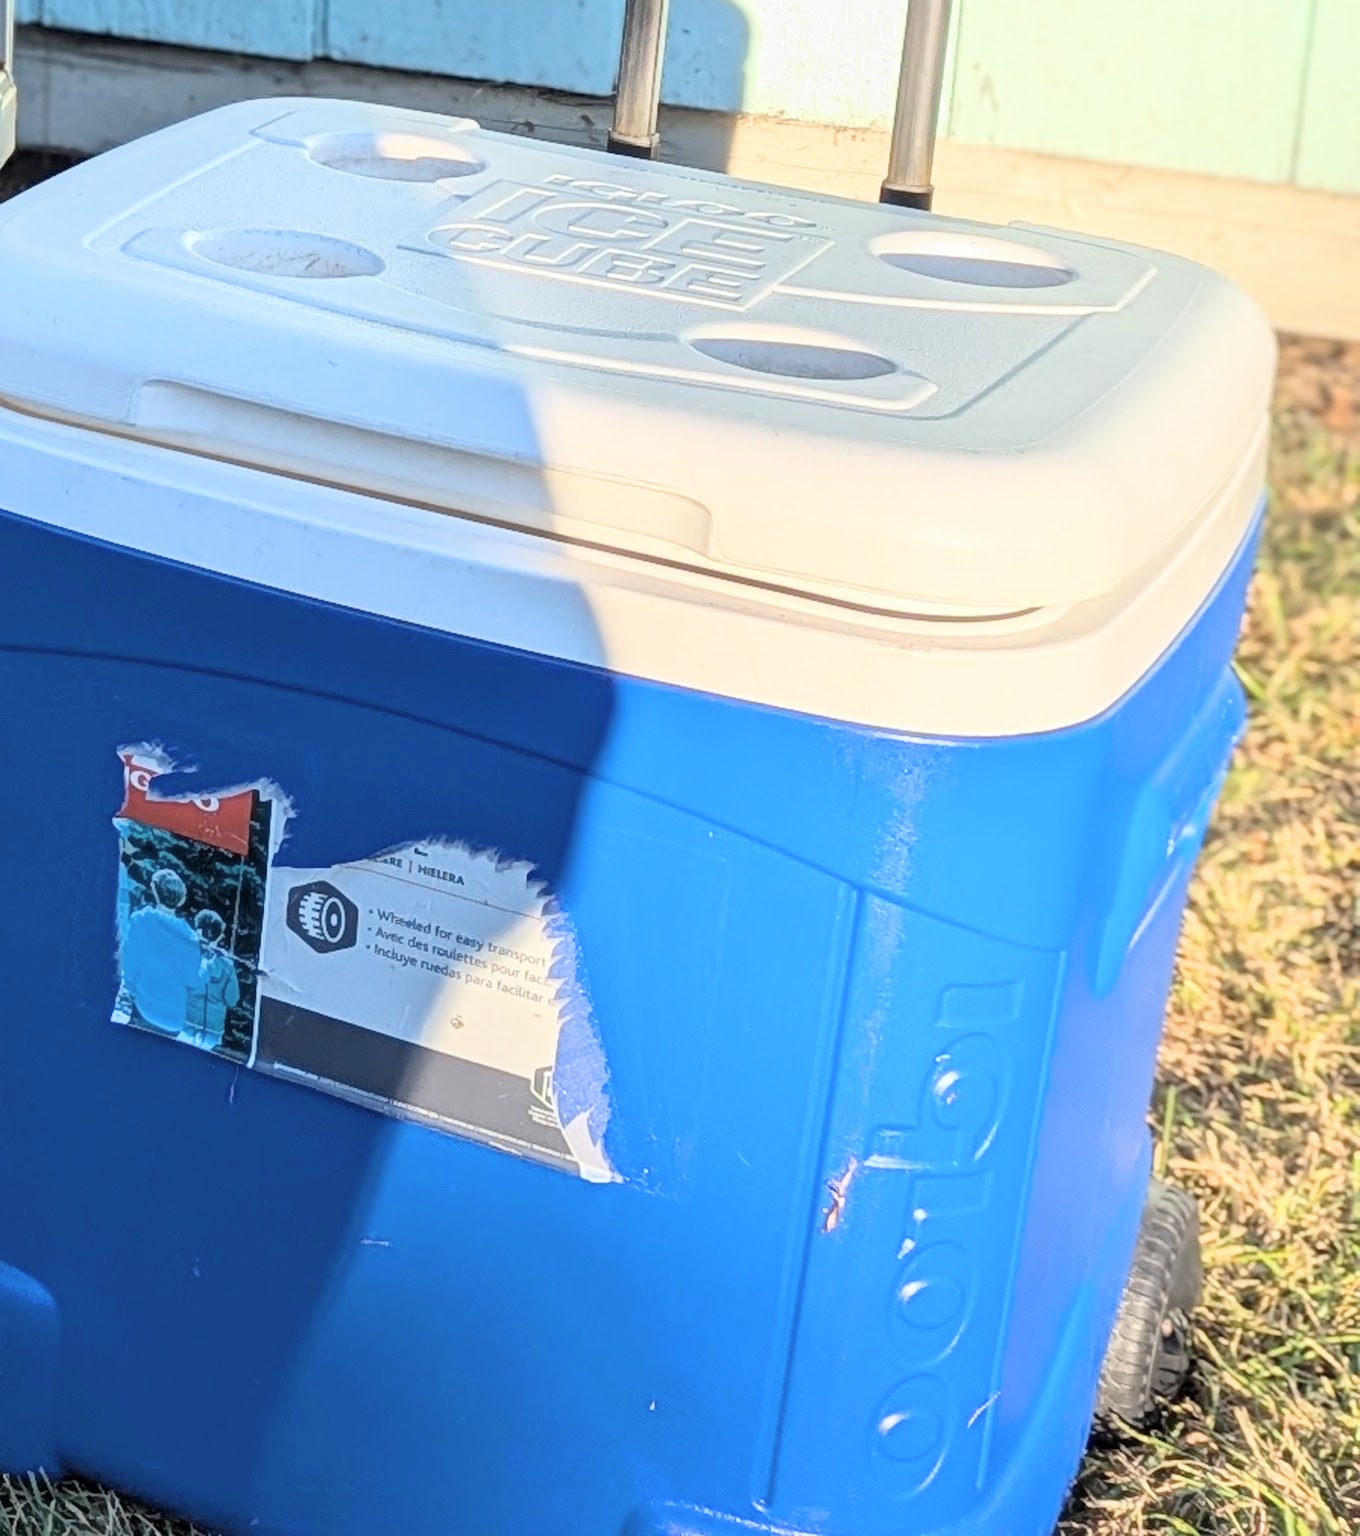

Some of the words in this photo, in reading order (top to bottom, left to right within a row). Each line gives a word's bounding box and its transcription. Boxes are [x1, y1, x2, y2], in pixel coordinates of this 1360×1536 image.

[473, 187, 794, 270] ICE
[426, 222, 761, 302] CUBE
[417, 864, 465, 886] HIELERA
[375, 927, 404, 944] Avec
[407, 936, 429, 952] des
[432, 944, 487, 969] roulettes
[491, 963, 520, 978] pour
[377, 908, 431, 934] Wheeled
[435, 925, 453, 941] for
[456, 934, 484, 952] easy
[488, 942, 546, 968] transport
[374, 943, 418, 967] Incluye
[420, 960, 462, 979] ruedas
[465, 973, 492, 989] para
[497, 981, 543, 1003] facilitar
